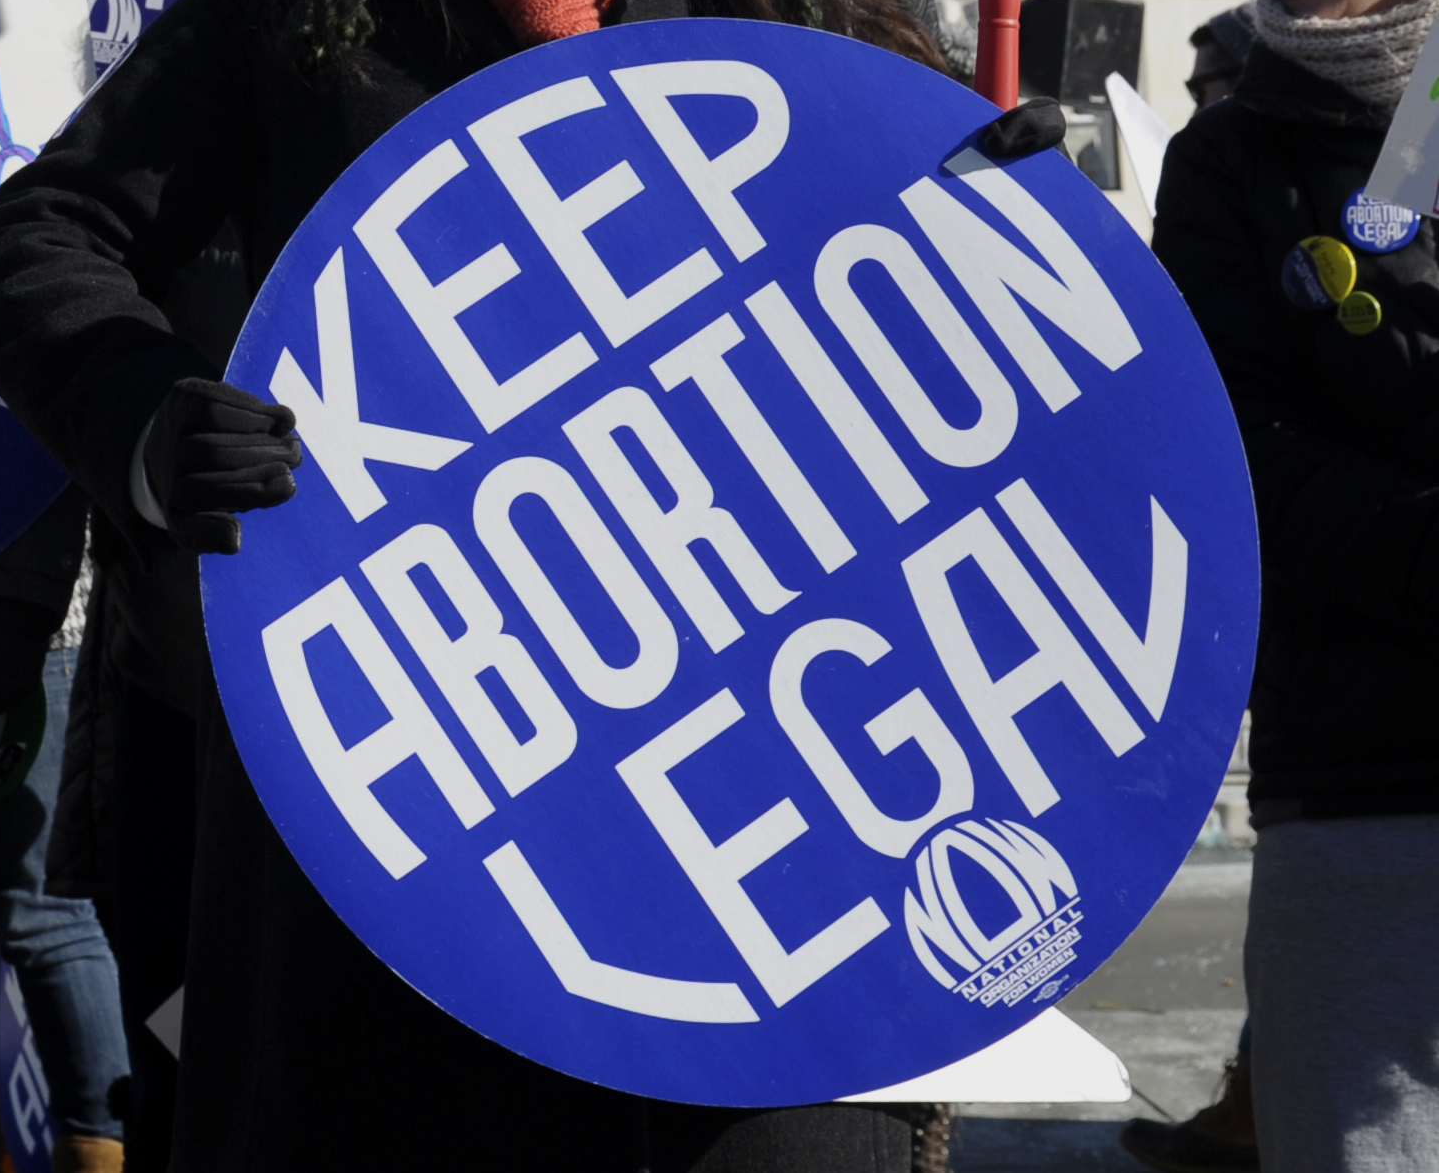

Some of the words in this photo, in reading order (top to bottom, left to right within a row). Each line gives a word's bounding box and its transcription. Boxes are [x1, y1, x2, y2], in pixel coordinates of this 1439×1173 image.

[268, 59, 790, 523] KEEP
[1353, 222, 1409, 241] LEGAL
[261, 146, 1143, 881] ABORTION
[482, 476, 1189, 1023] LEGAL
[904, 817, 1079, 990] NOW
[961, 908, 1083, 1000] NATIONAL
[979, 926, 1080, 1005] ORGANIZATION
[1002, 983, 1028, 1005] FOR
[1026, 947, 1076, 988] WOMEN
